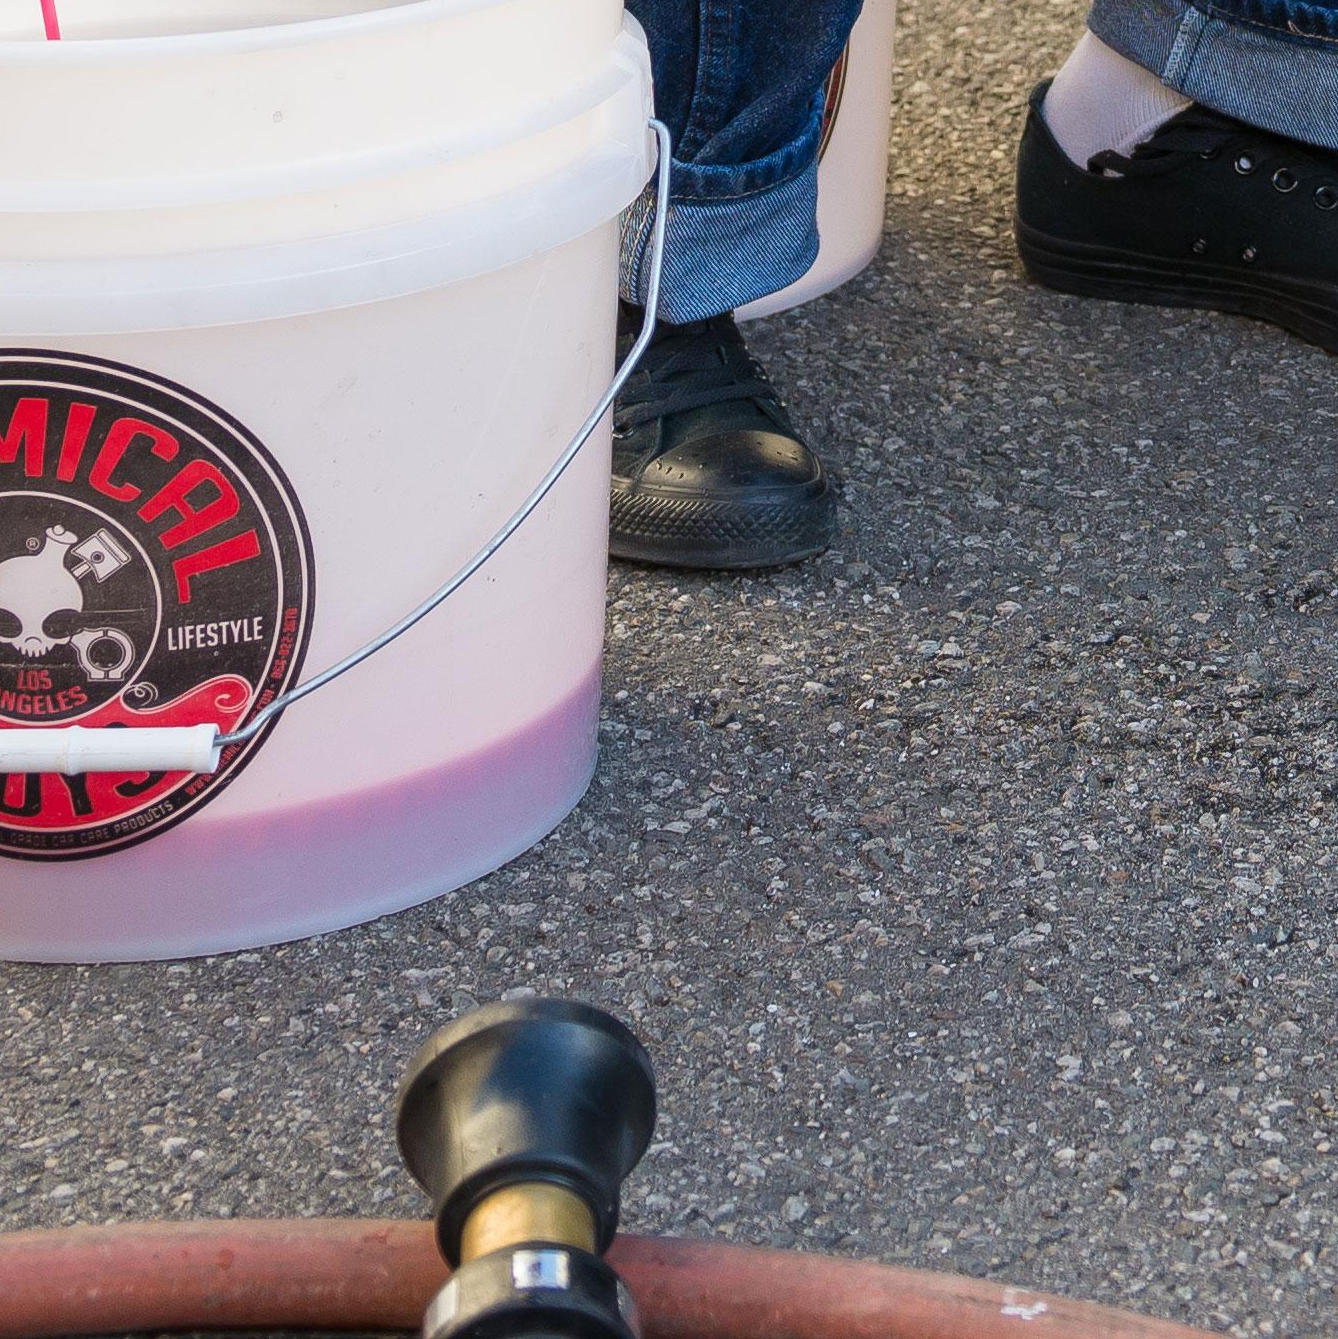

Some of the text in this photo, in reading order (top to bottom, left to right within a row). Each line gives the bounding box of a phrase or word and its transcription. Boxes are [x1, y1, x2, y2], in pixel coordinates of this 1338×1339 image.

[167, 615, 264, 651] LIFESTYLE
[17, 668, 53, 690] LOS
[81, 829, 110, 845] CARE
[113, 800, 174, 835] PRODUCTS
